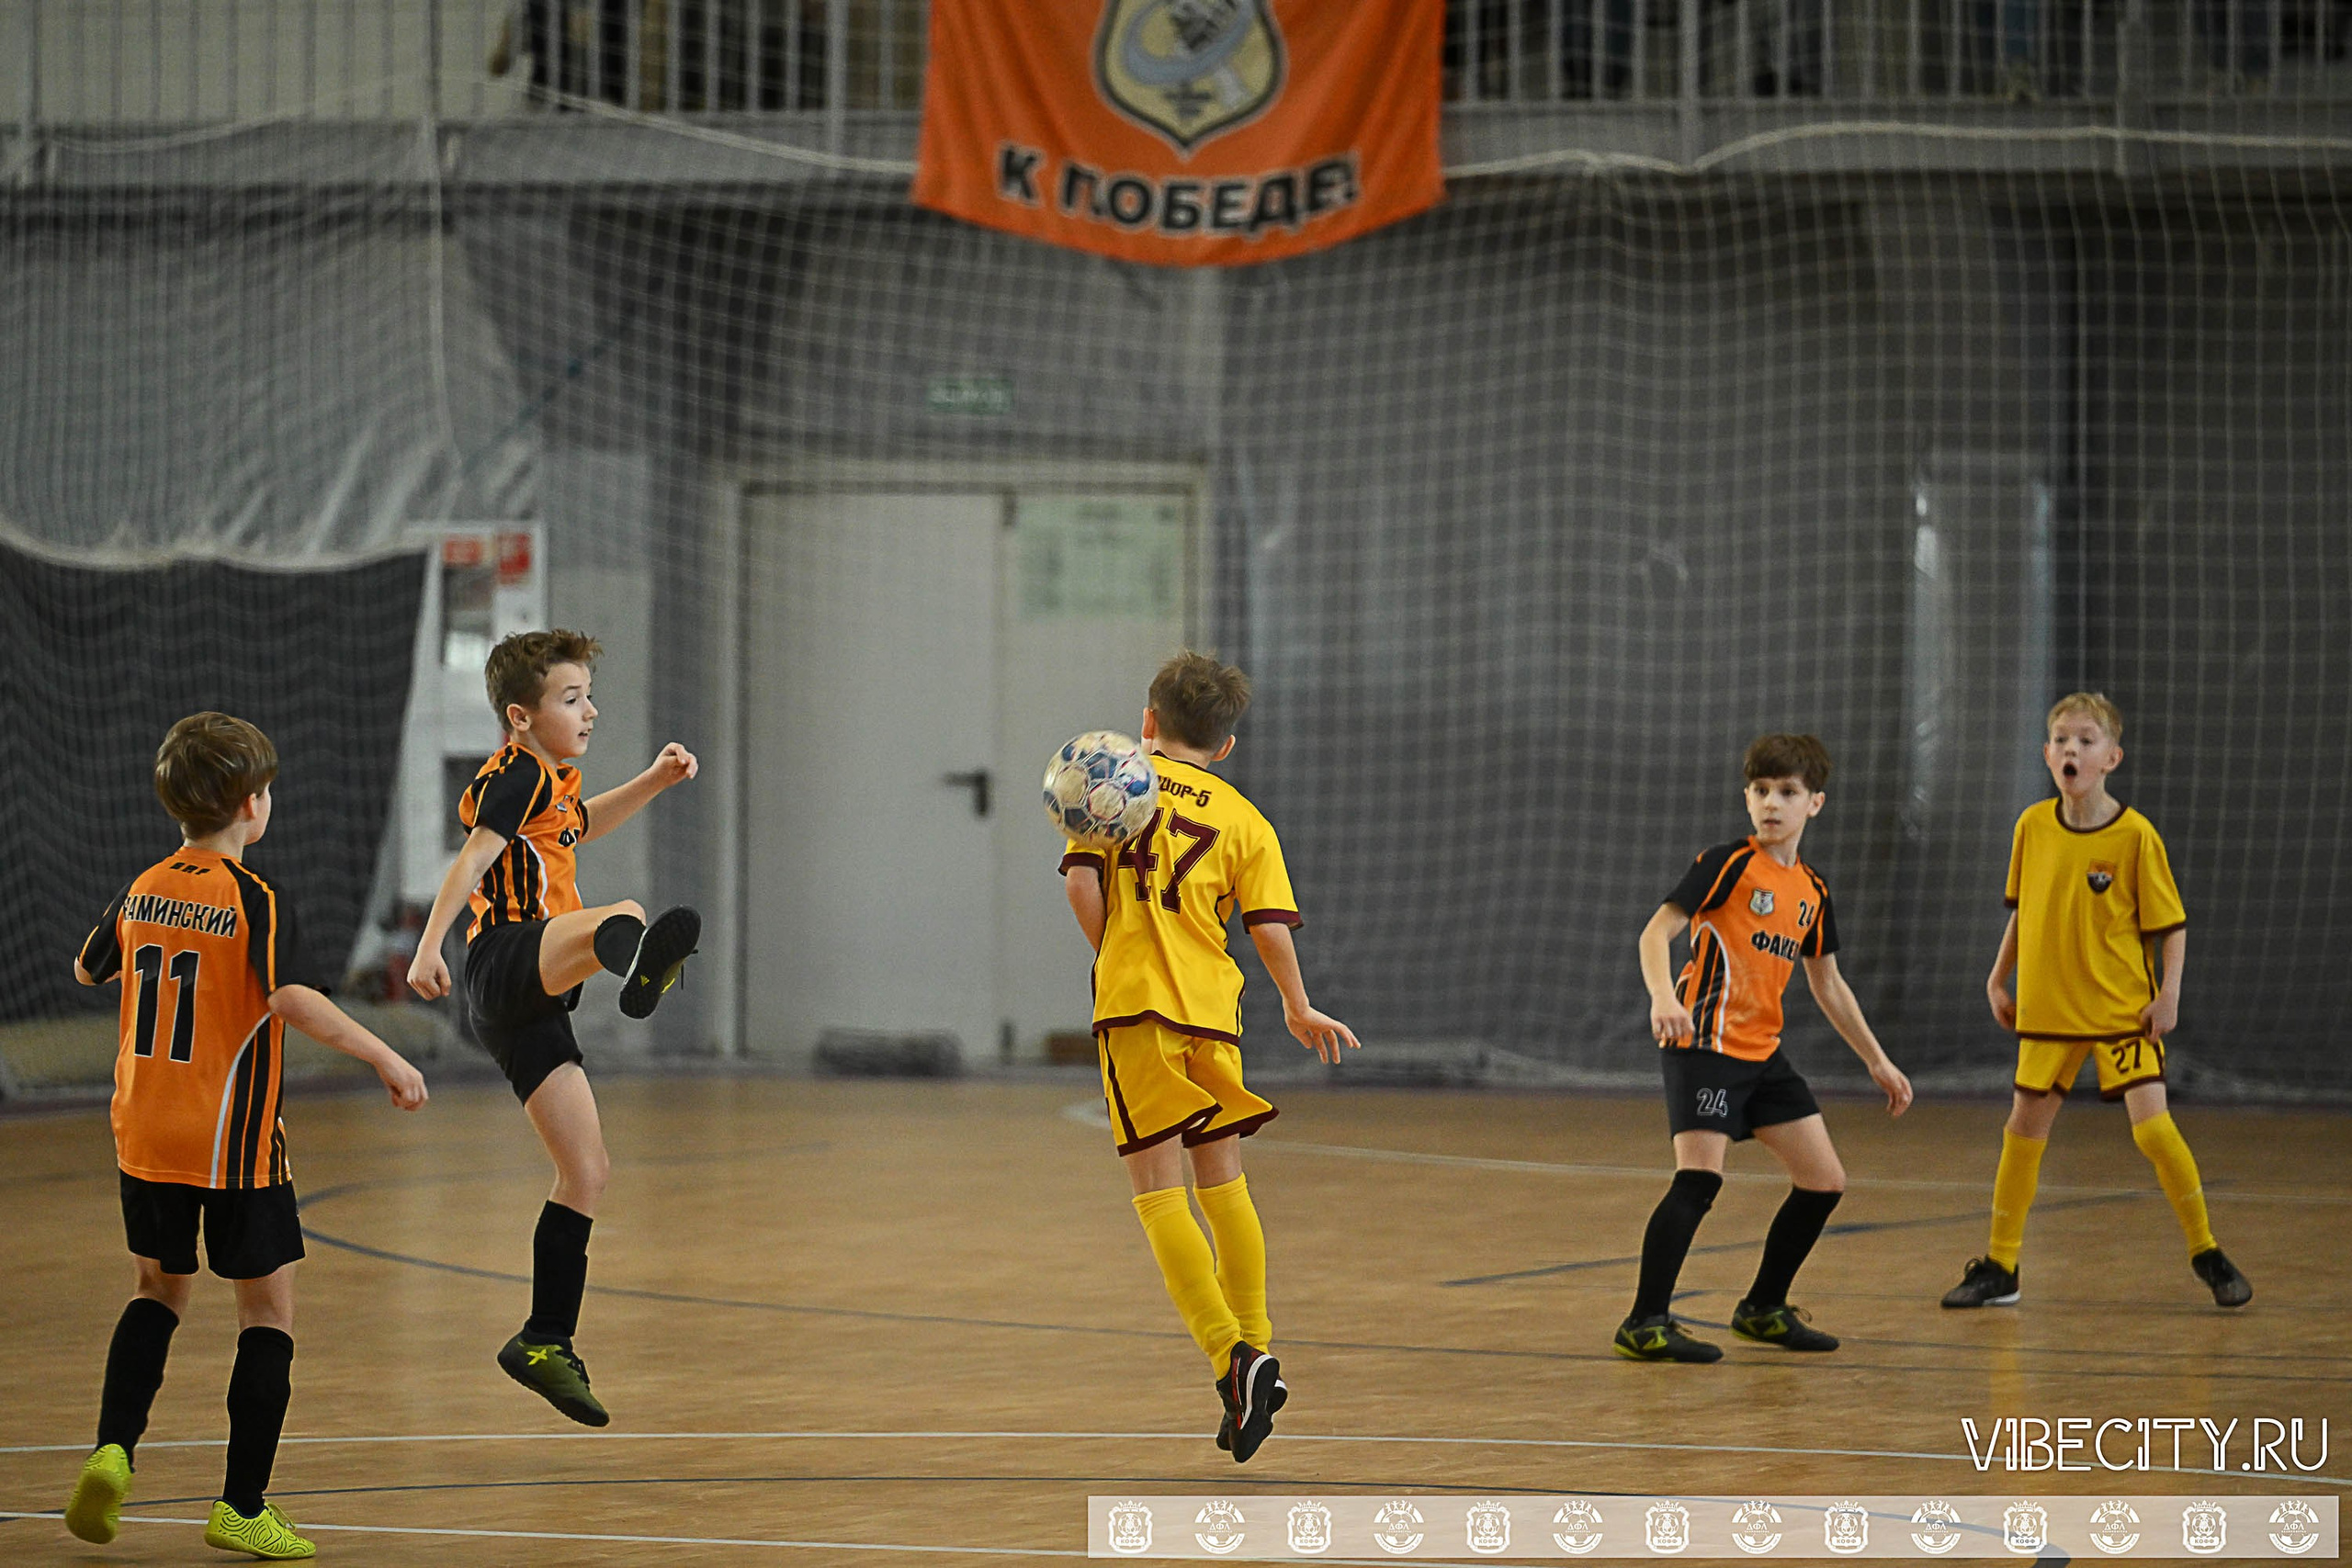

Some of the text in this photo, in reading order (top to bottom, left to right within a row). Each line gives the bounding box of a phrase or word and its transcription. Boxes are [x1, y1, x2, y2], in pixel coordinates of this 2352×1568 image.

[1001, 145, 1043, 203] К
[1117, 807, 1220, 913] 47
[134, 943, 200, 1063] 11
[2111, 1040, 2142, 1074] 27
[1697, 1088, 1729, 1117] 24
